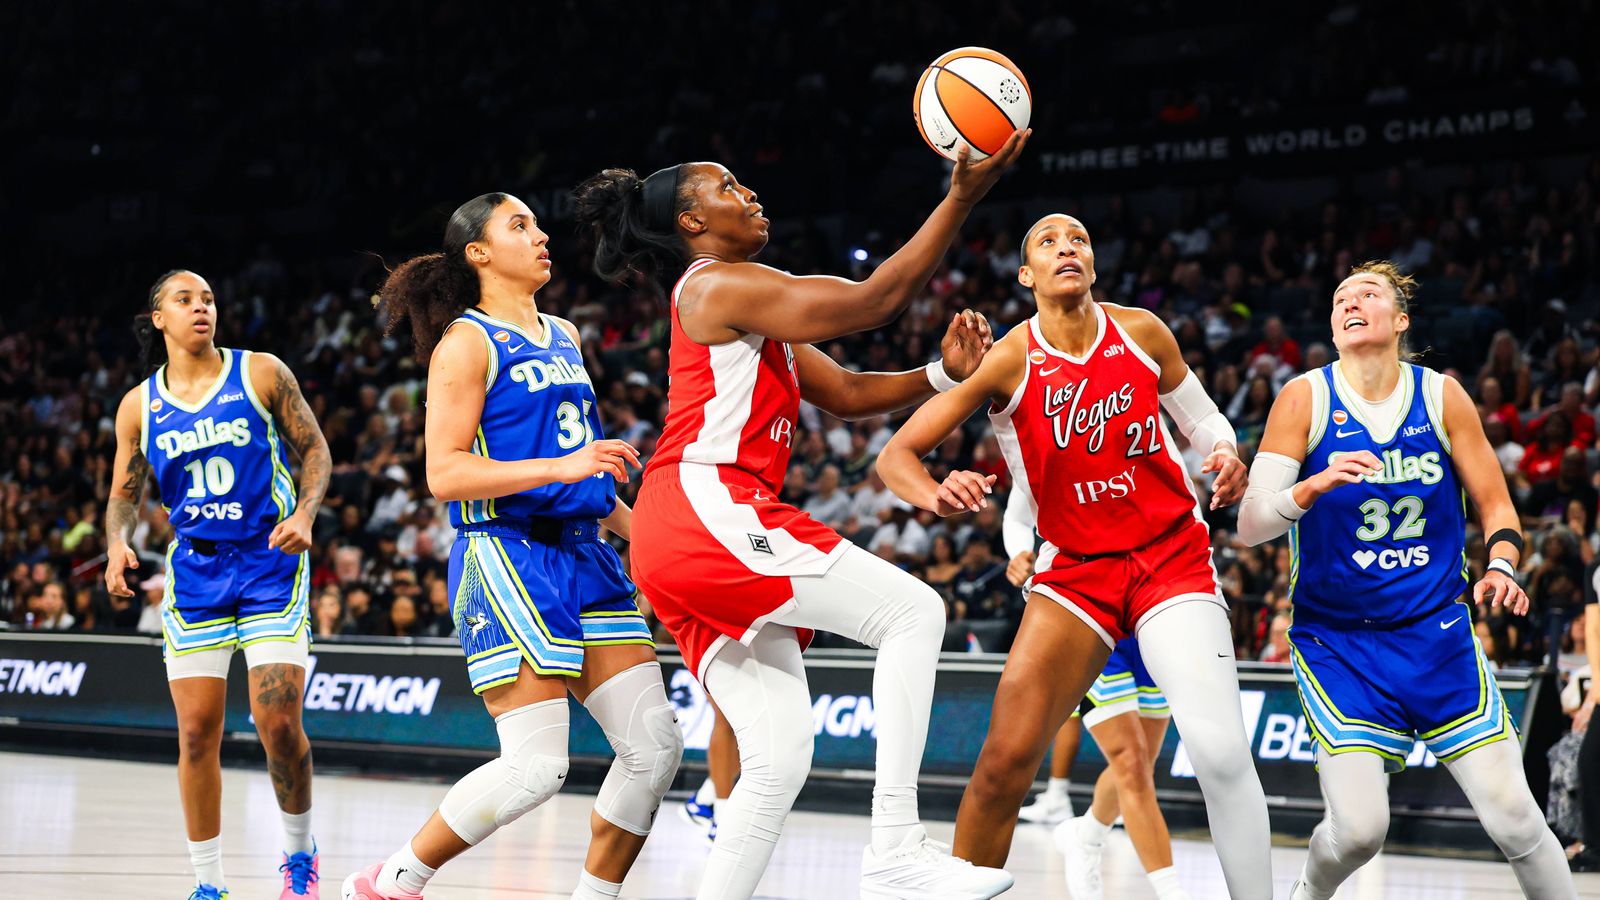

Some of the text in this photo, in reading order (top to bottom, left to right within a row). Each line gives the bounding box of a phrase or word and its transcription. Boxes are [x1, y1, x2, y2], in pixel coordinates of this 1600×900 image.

[1039, 107, 1535, 174] THREE-TIME WORLD CHAMPS
[1104, 344, 1125, 358] ally
[509, 355, 597, 393] Dalla
[217, 392, 244, 405] Albert
[1044, 381, 1076, 418] Las
[1052, 377, 1136, 453] Vegas
[155, 416, 252, 460] Dallas
[1125, 415, 1162, 458] 22
[1402, 422, 1432, 438] Albert
[184, 455, 235, 498] 10
[1073, 466, 1136, 504] IPSY
[1328, 448, 1444, 485] allas
[201, 501, 243, 520] CVS
[1355, 495, 1426, 542] 32
[1378, 545, 1430, 570] CVS
[0, 658, 87, 697] ETMGM
[304, 672, 441, 716] BETMGM
